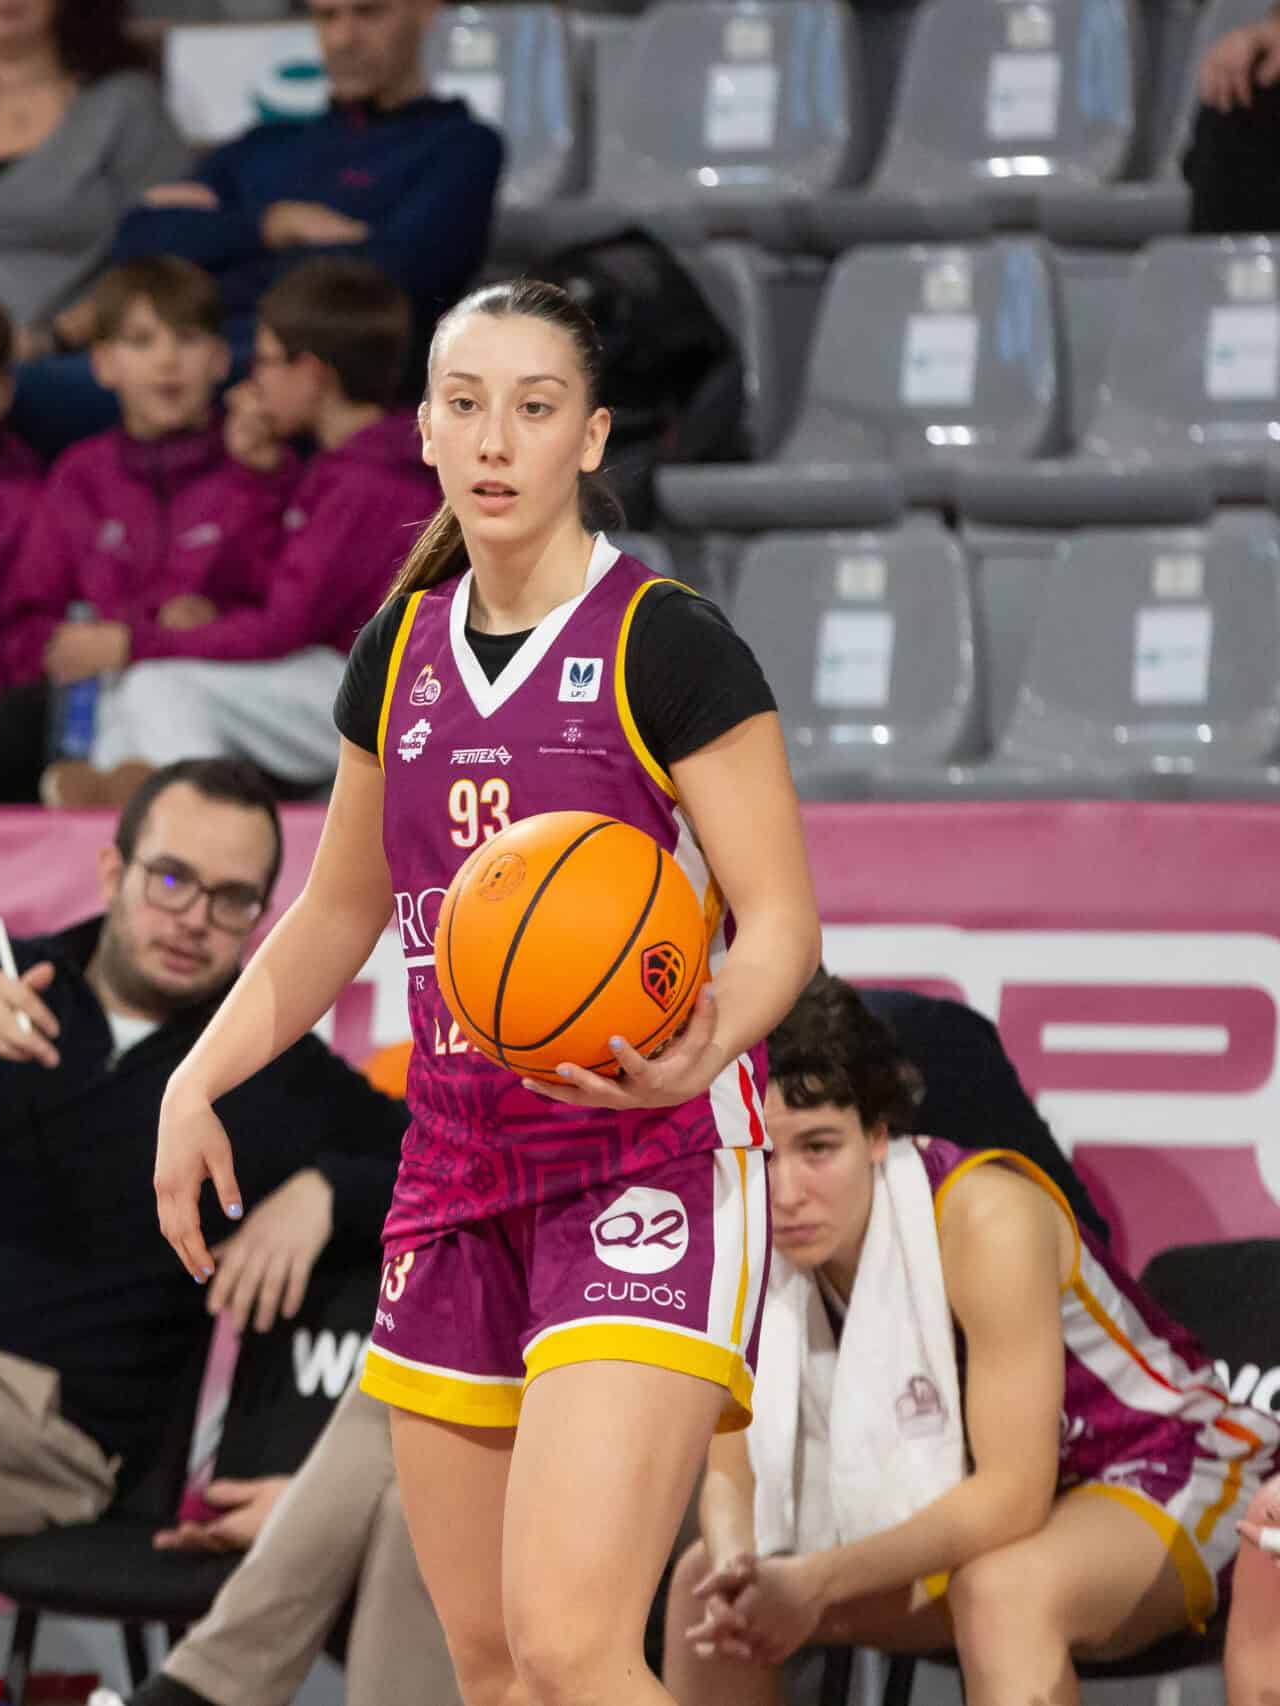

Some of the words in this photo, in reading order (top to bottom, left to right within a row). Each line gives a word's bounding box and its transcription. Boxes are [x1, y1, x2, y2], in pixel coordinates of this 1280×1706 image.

[450, 748, 497, 764] PENTEX
[448, 777, 512, 848] 93
[596, 1209, 684, 1249] Q2
[380, 1251, 415, 1302] 3
[584, 1282, 687, 1310] CUDÓS
